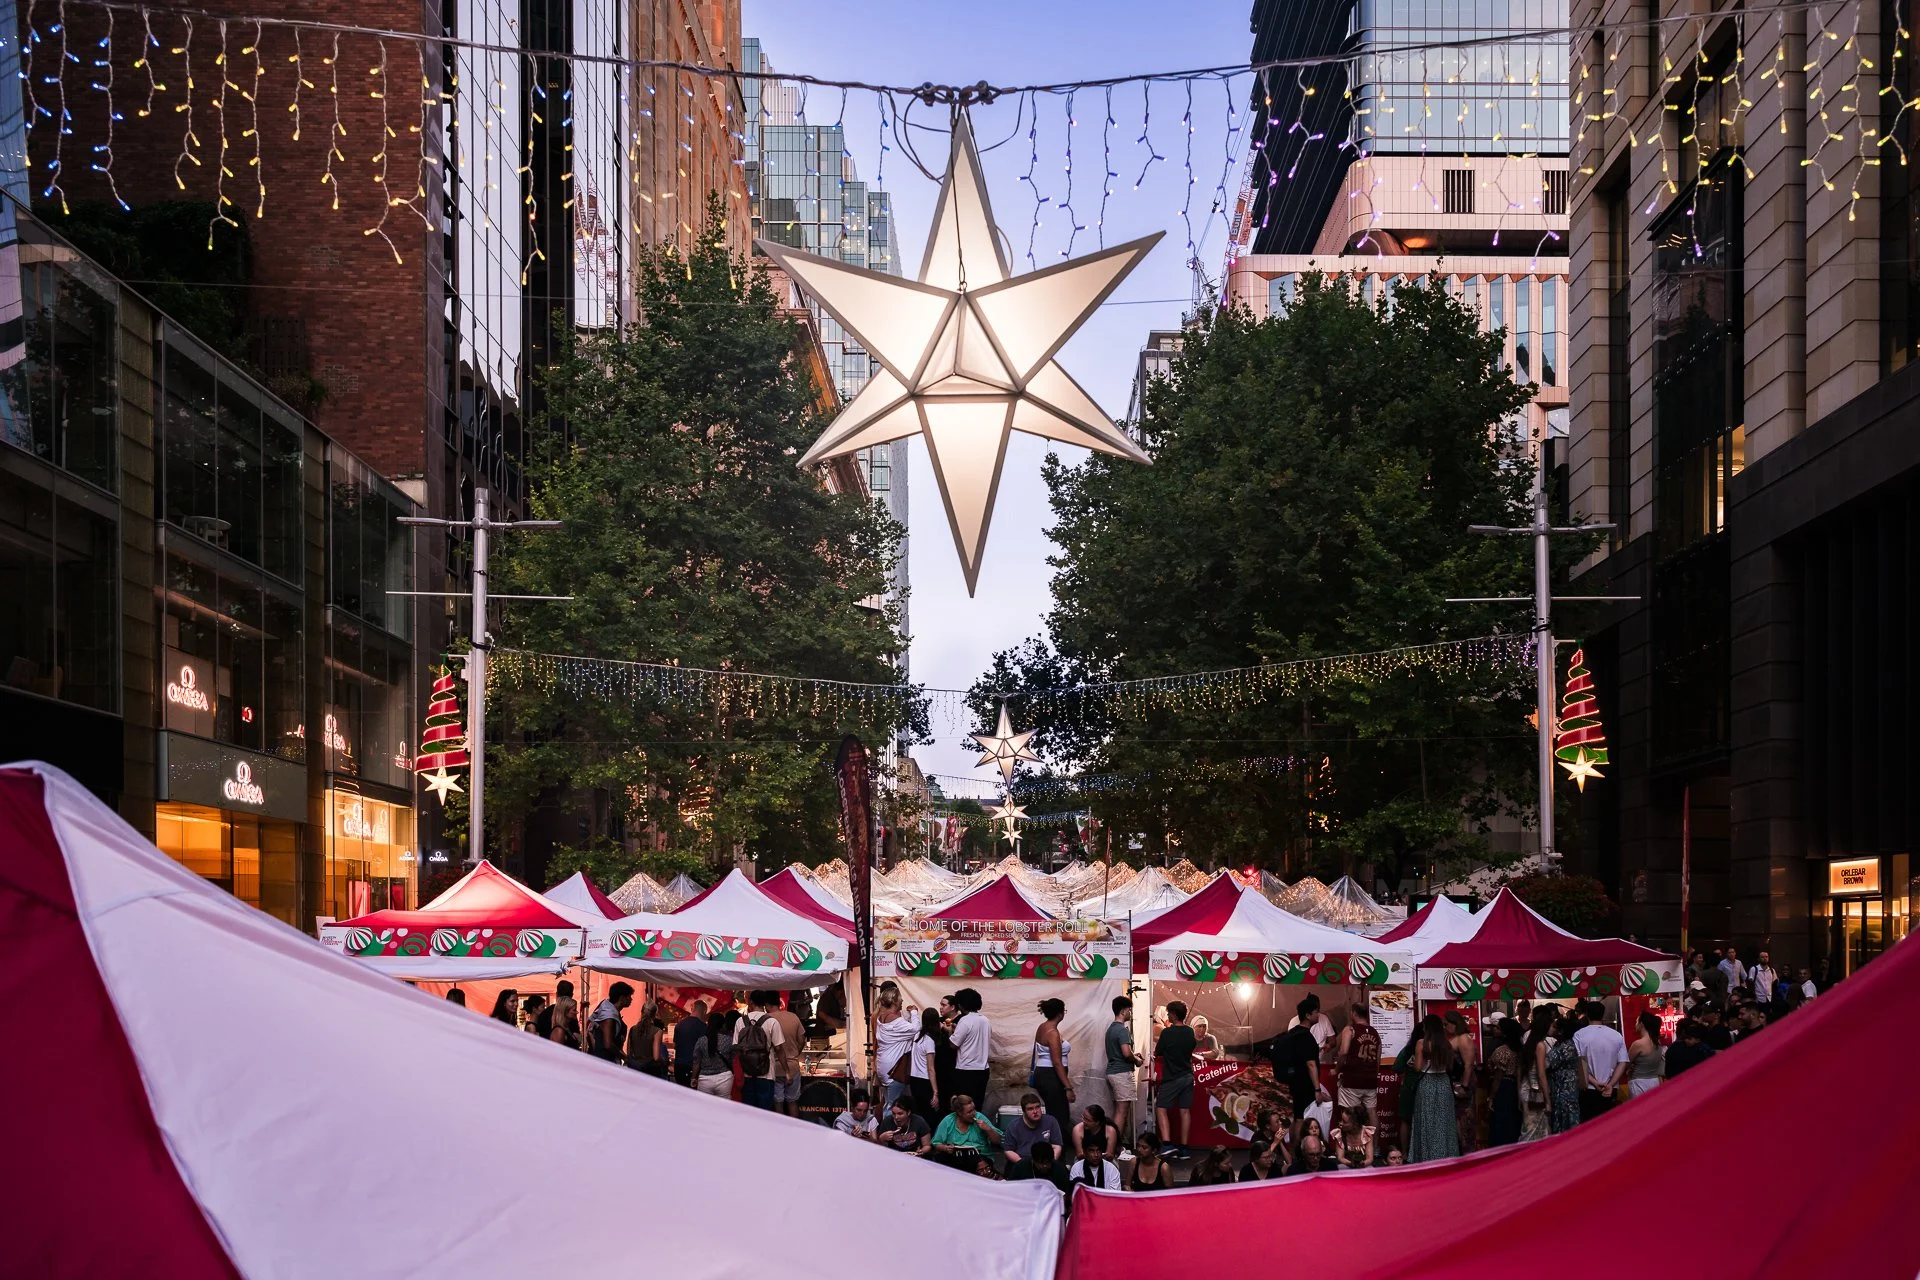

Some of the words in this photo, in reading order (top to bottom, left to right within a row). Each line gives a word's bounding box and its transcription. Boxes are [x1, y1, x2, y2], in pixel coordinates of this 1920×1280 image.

[167, 683, 209, 711] OMEGA
[224, 779, 265, 805] OMEGA
[1841, 868, 1866, 877] ORLEBAR
[1843, 876, 1864, 885] BROWN
[852, 887, 861, 915] AND
[908, 920, 948, 932] HOME
[951, 920, 968, 932] OF
[970, 921, 995, 932] THE
[999, 921, 1055, 933] LOBSTER
[1056, 921, 1088, 933] ROLL
[1358, 1044, 1377, 1060] 45
[1193, 1060, 1208, 1071] ish
[1198, 1062, 1238, 1083] Catering
